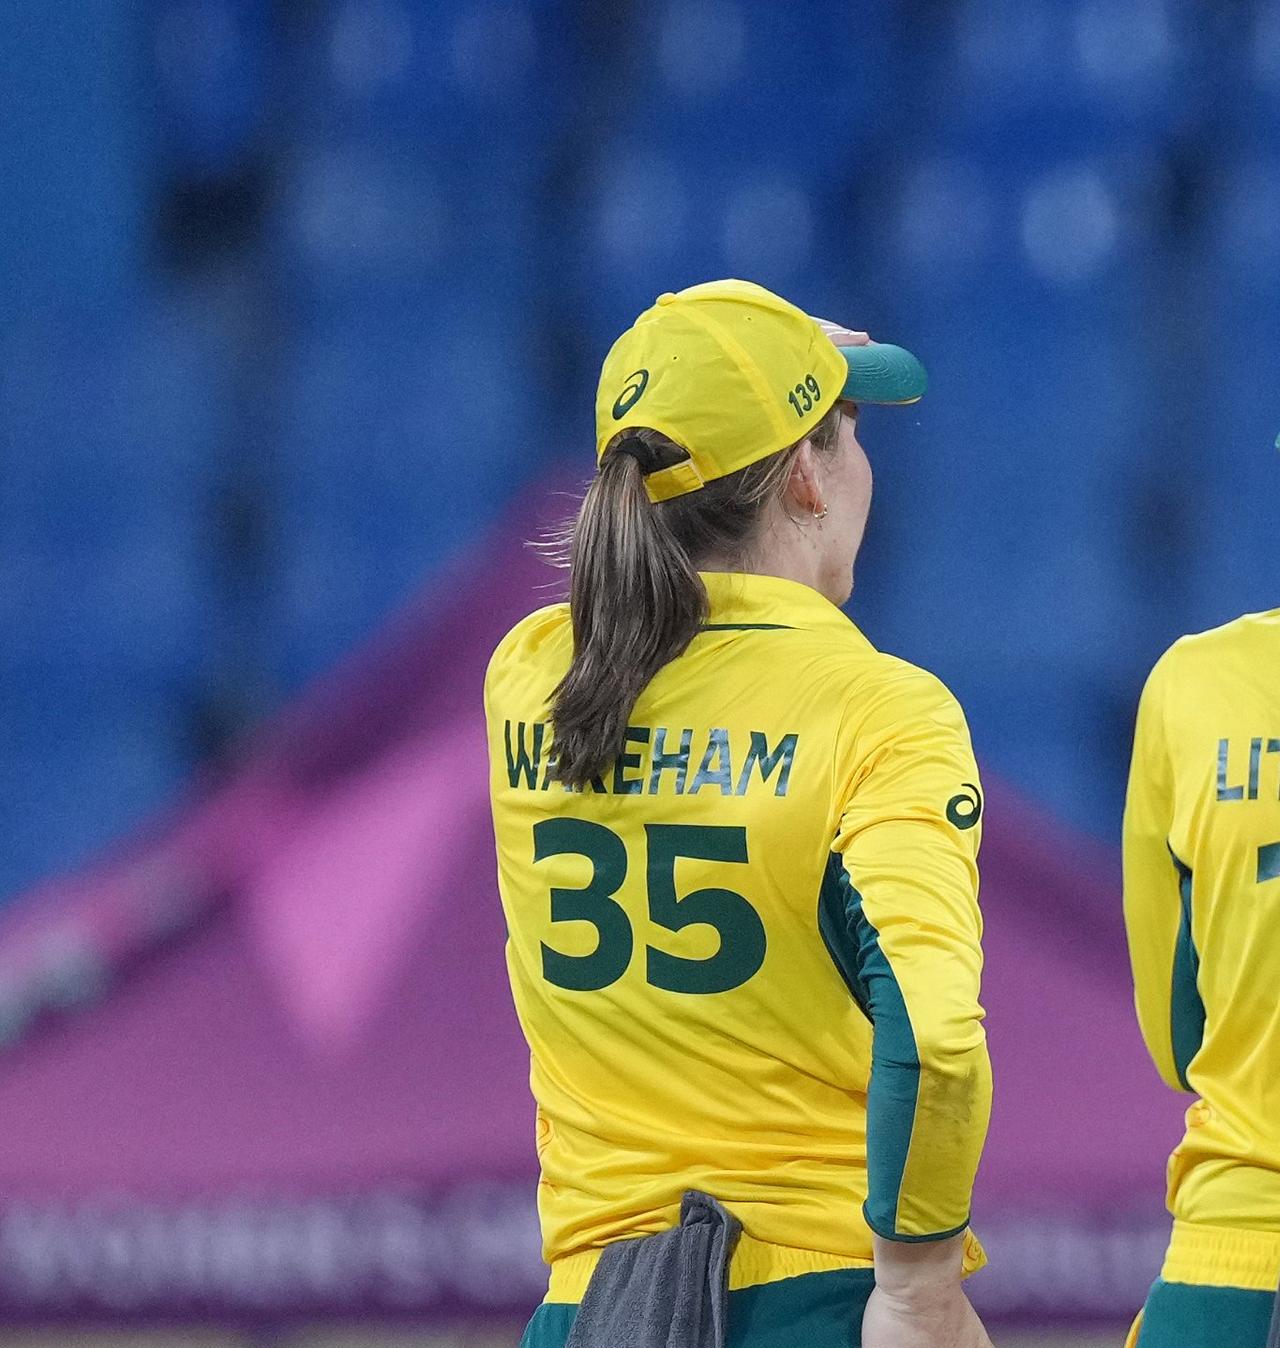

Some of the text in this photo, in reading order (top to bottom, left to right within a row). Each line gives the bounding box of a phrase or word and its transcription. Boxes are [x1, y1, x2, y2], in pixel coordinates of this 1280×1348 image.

[788, 373, 821, 418] 139
[504, 719, 799, 798] WEHAM
[533, 816, 767, 995] 35
